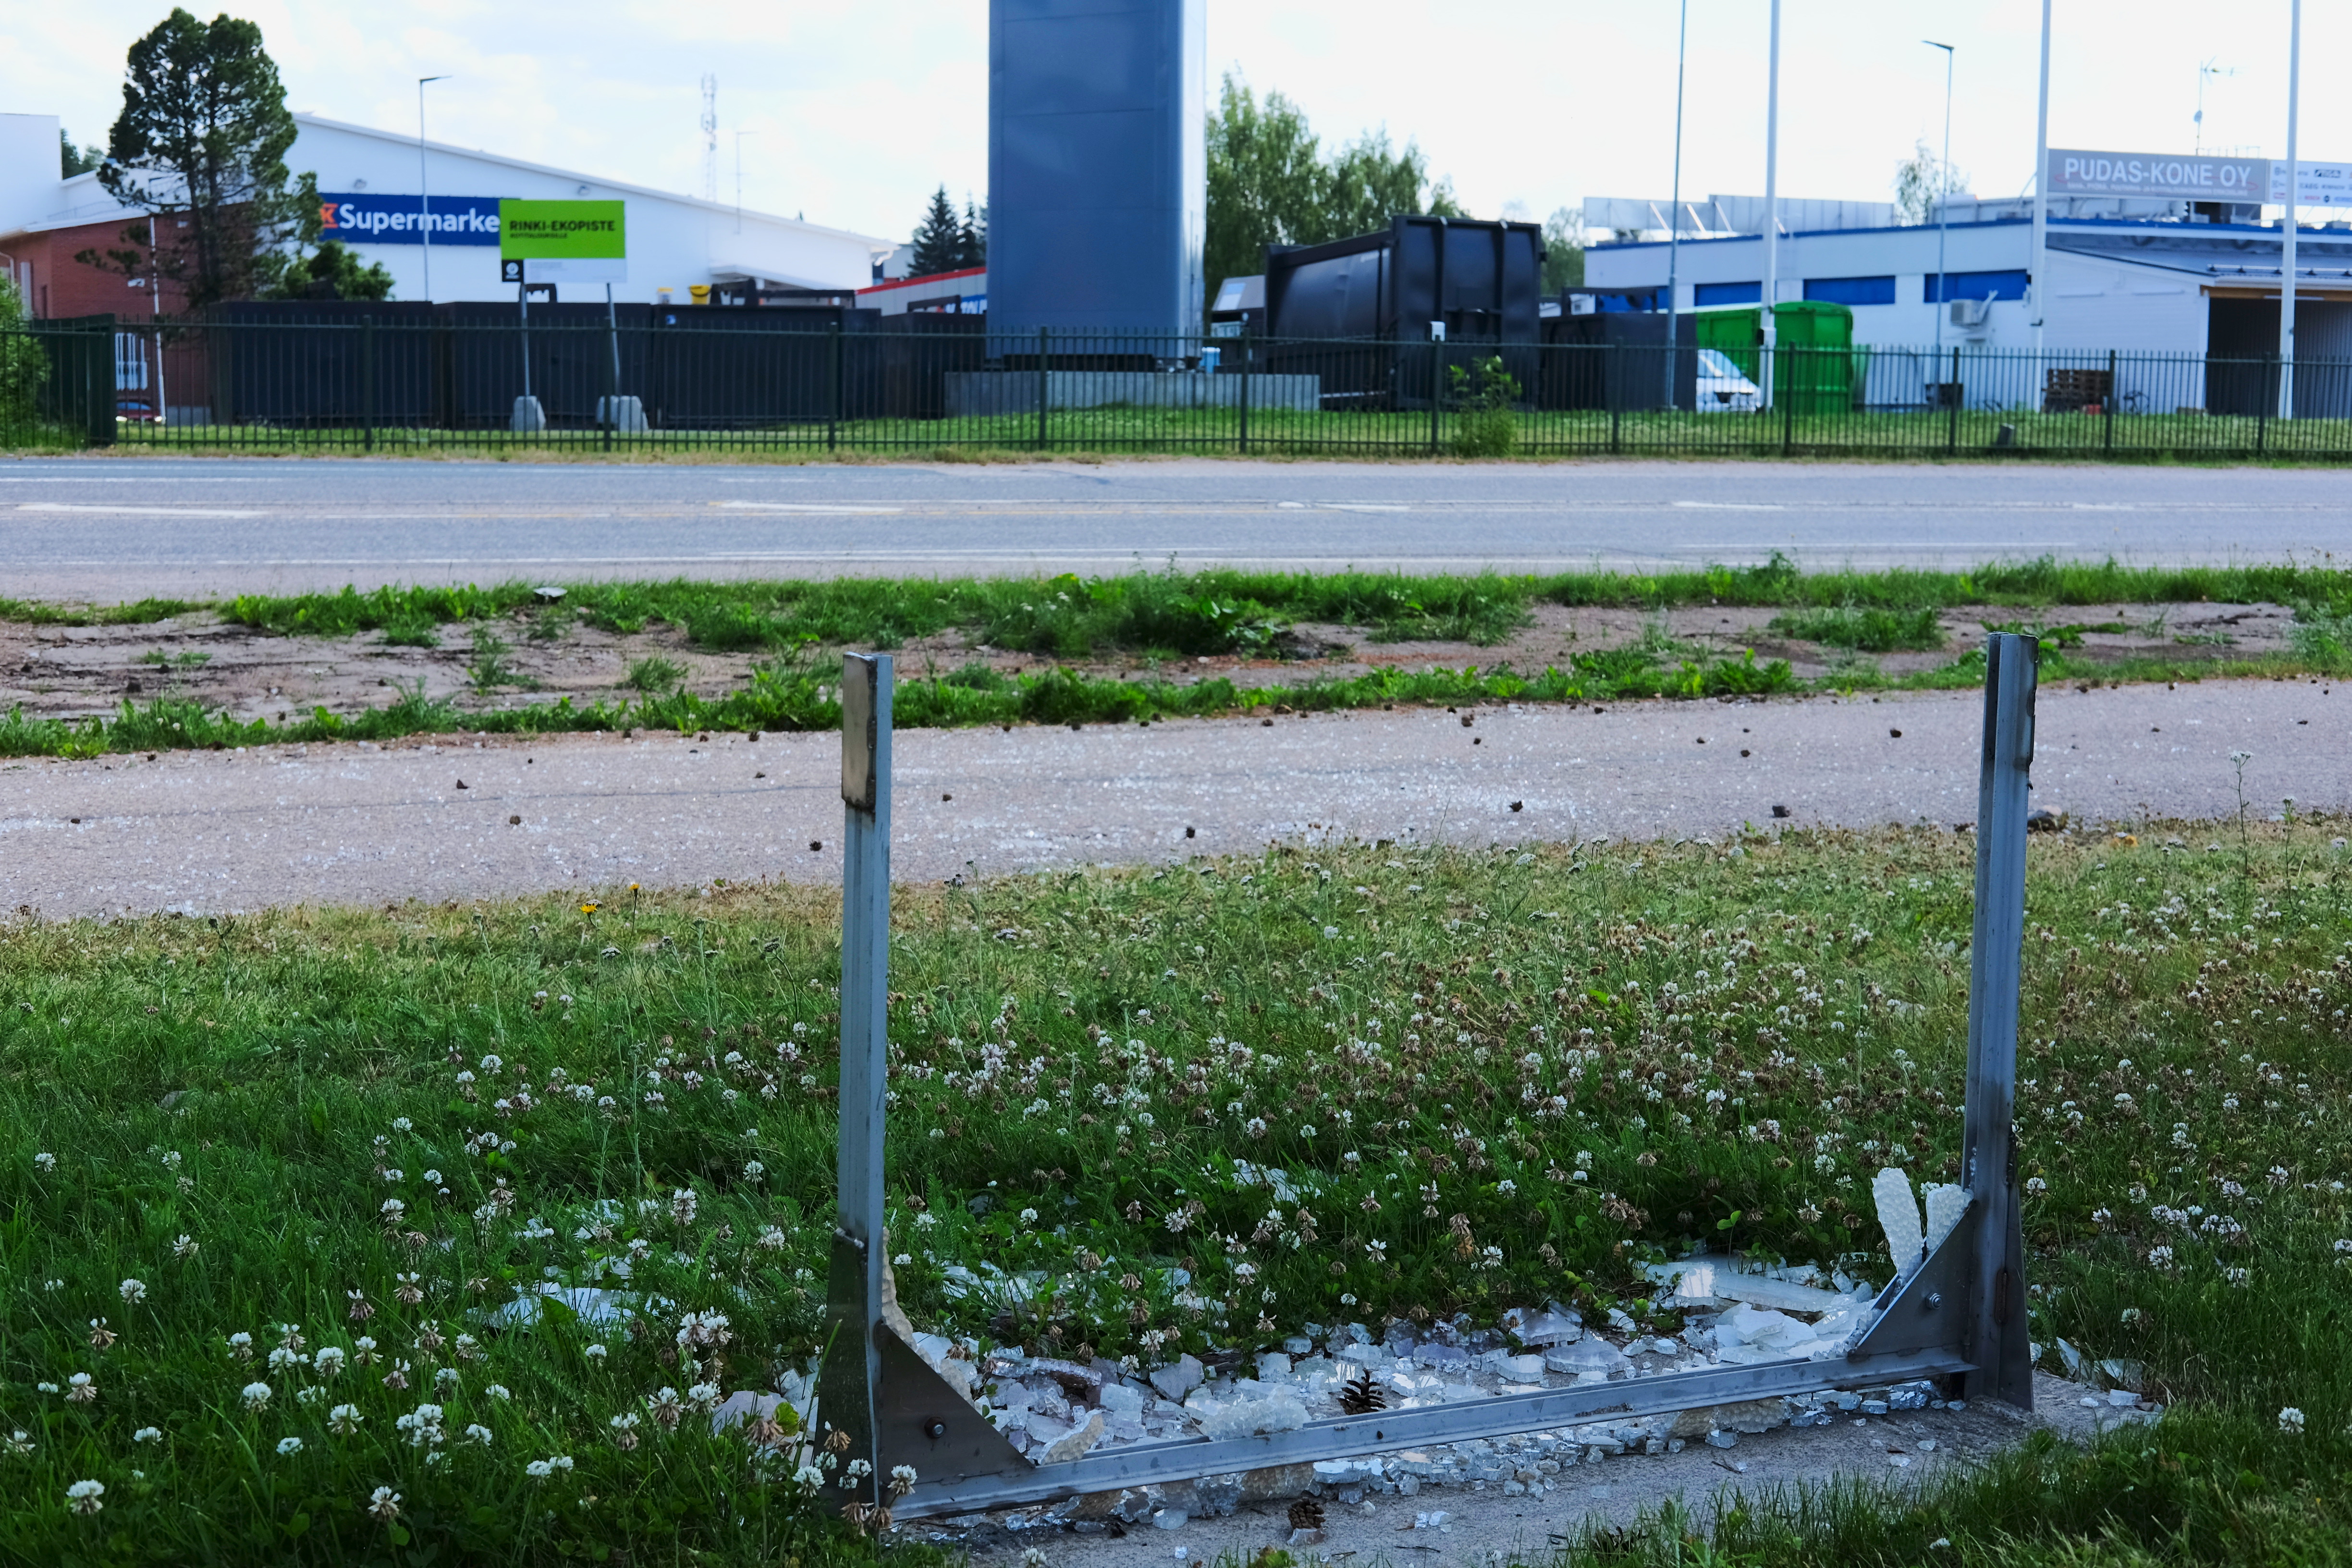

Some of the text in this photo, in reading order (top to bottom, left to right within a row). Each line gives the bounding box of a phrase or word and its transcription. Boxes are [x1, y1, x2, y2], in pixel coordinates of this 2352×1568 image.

[2065, 158, 2251, 187] PUDAS-KONE OY
[339, 203, 501, 235] Supermarke
[509, 220, 615, 232] RINKI-EKOPISTE
